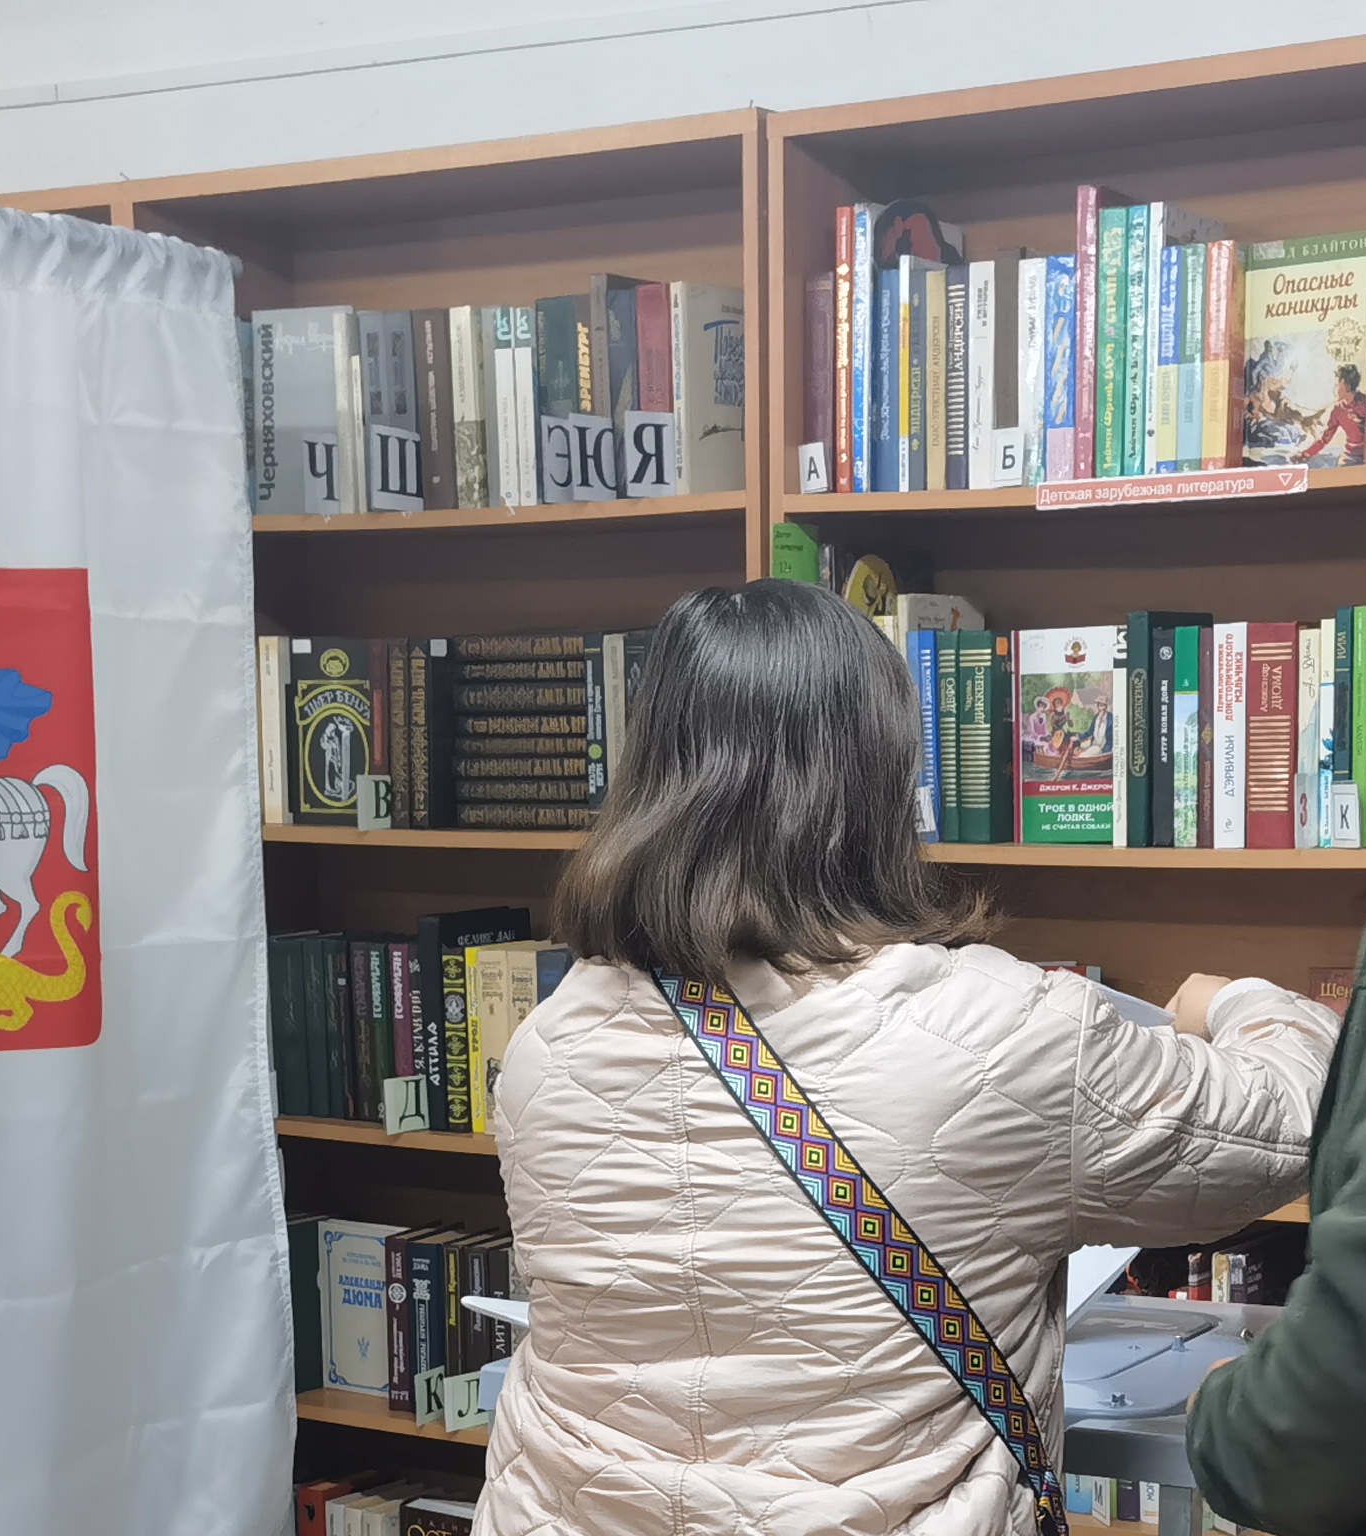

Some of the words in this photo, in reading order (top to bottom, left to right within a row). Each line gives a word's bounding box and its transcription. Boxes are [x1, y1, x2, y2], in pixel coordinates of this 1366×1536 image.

[1272, 272, 1354, 295] Опасные
[1264, 293, 1359, 322] каникулы
[954, 302, 965, 369] АНДЕРСЕН
[577, 321, 592, 412] ЭРЕНБУРГ
[258, 324, 278, 500] Черняховский
[304, 440, 339, 501] Ч
[377, 433, 425, 499] Ш
[547, 425, 571, 487] Э
[629, 423, 671, 485] Я
[807, 456, 820, 481] А
[1001, 444, 1015, 469] Б
[1040, 487, 1093, 506] Детская
[1094, 482, 1173, 503] зарубежная
[1175, 476, 1255, 498] литература
[1336, 630, 1347, 659] КИМ
[1160, 679, 1169, 703] ДОЙЛ
[1216, 644, 1224, 712] Приключения
[1270, 665, 1284, 710] ДЮМА
[945, 677, 956, 713] ДЕФО
[973, 667, 985, 724] ДИККЕНС
[1160, 705, 1168, 734] КОНАН
[1160, 735, 1168, 763] АРТУР
[1039, 784, 1071, 792] ДЖЕРОМ
[1038, 804, 1066, 813] ТРОЕ
[1069, 804, 1076, 812] В
[1078, 802, 1114, 812] ОДНОЙ
[1057, 813, 1094, 822] ЛОДКЕ,
[1339, 803, 1350, 830] К
[427, 1021, 440, 1086] АТТИЛА
[398, 1079, 427, 1130] Д
[342, 1288, 383, 1309] ДЮМА
[424, 1373, 445, 1415] К
